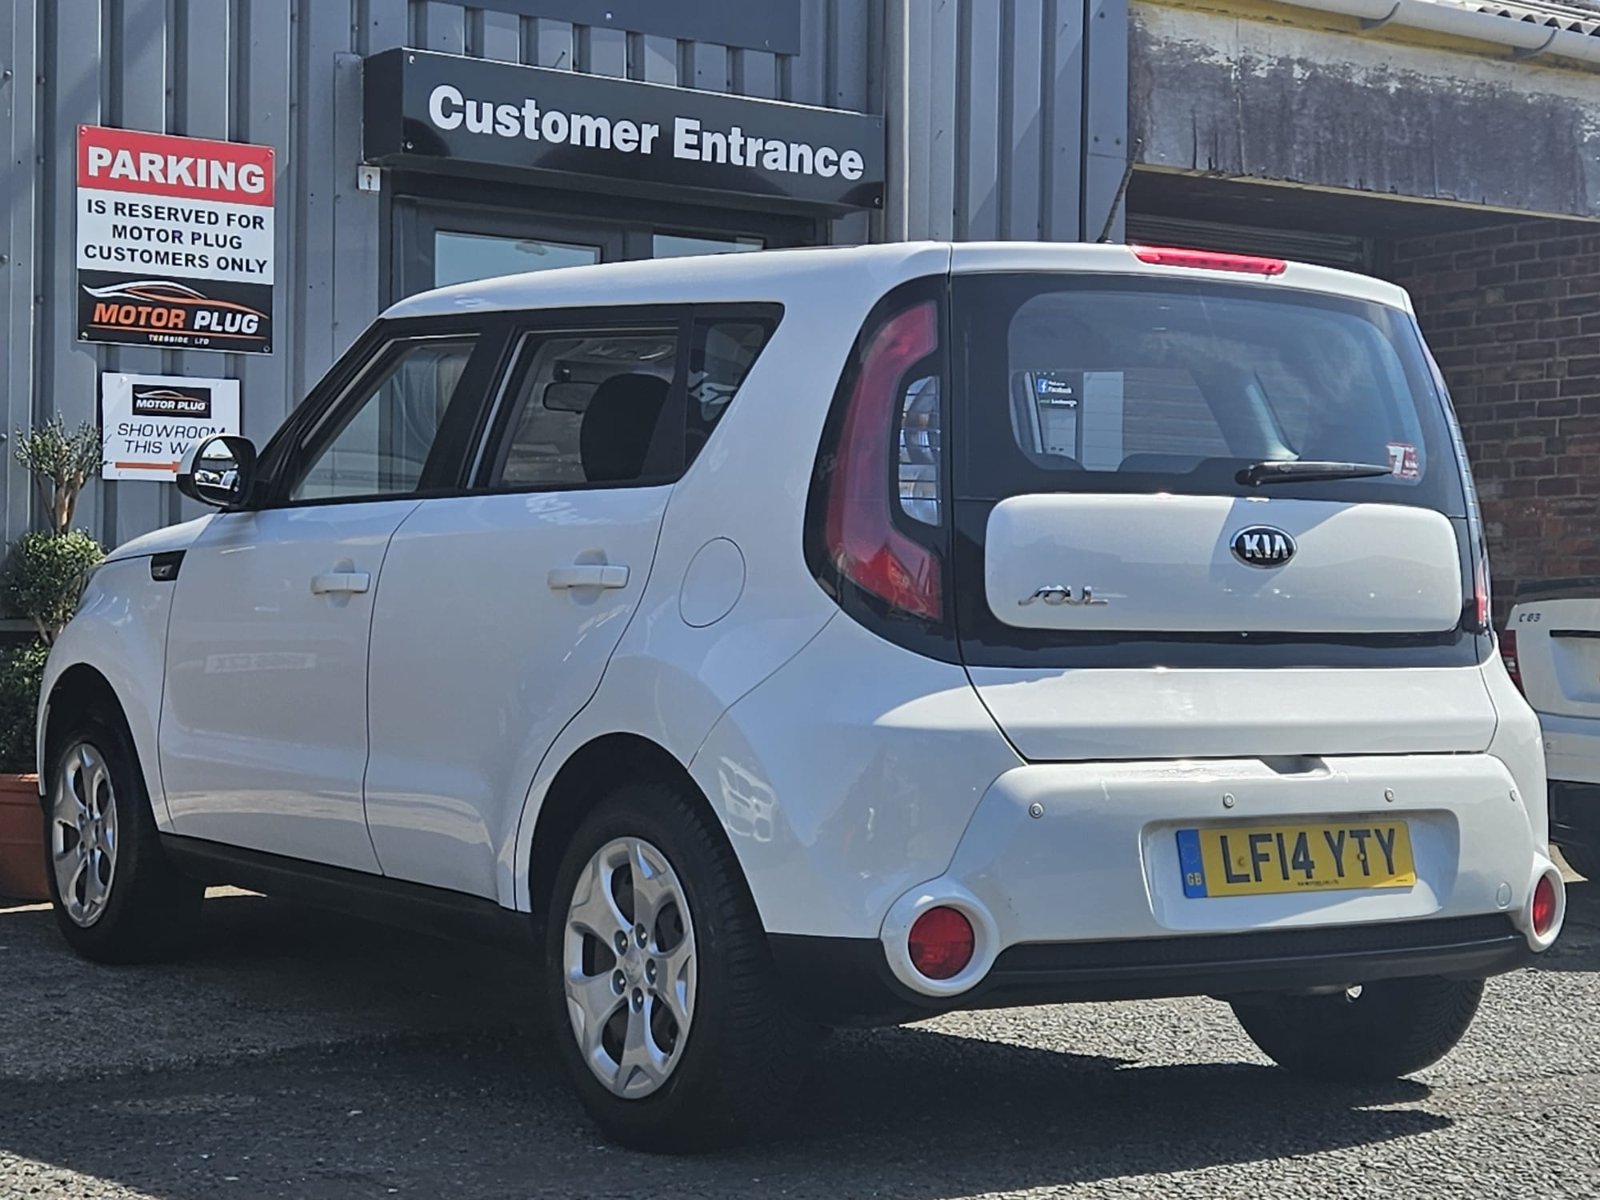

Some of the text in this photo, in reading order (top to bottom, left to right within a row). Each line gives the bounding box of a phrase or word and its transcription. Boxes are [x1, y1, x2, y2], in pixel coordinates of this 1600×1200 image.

[428, 83, 866, 182] Customer Entrance
[87, 146, 266, 194] PARKING
[87, 198, 265, 230] IS RESERVED FOR
[112, 224, 243, 250] MOTOR PLUG
[84, 244, 268, 274] CUSTOMERS ONLY
[93, 303, 259, 334] MOTOR PLUG
[136, 399, 206, 411] MOTOR PLUG
[124, 439, 162, 454] THIS
[1242, 533, 1289, 558] KIA
[1220, 828, 1396, 884] LF14 YTY
[1187, 872, 1203, 886] GB
